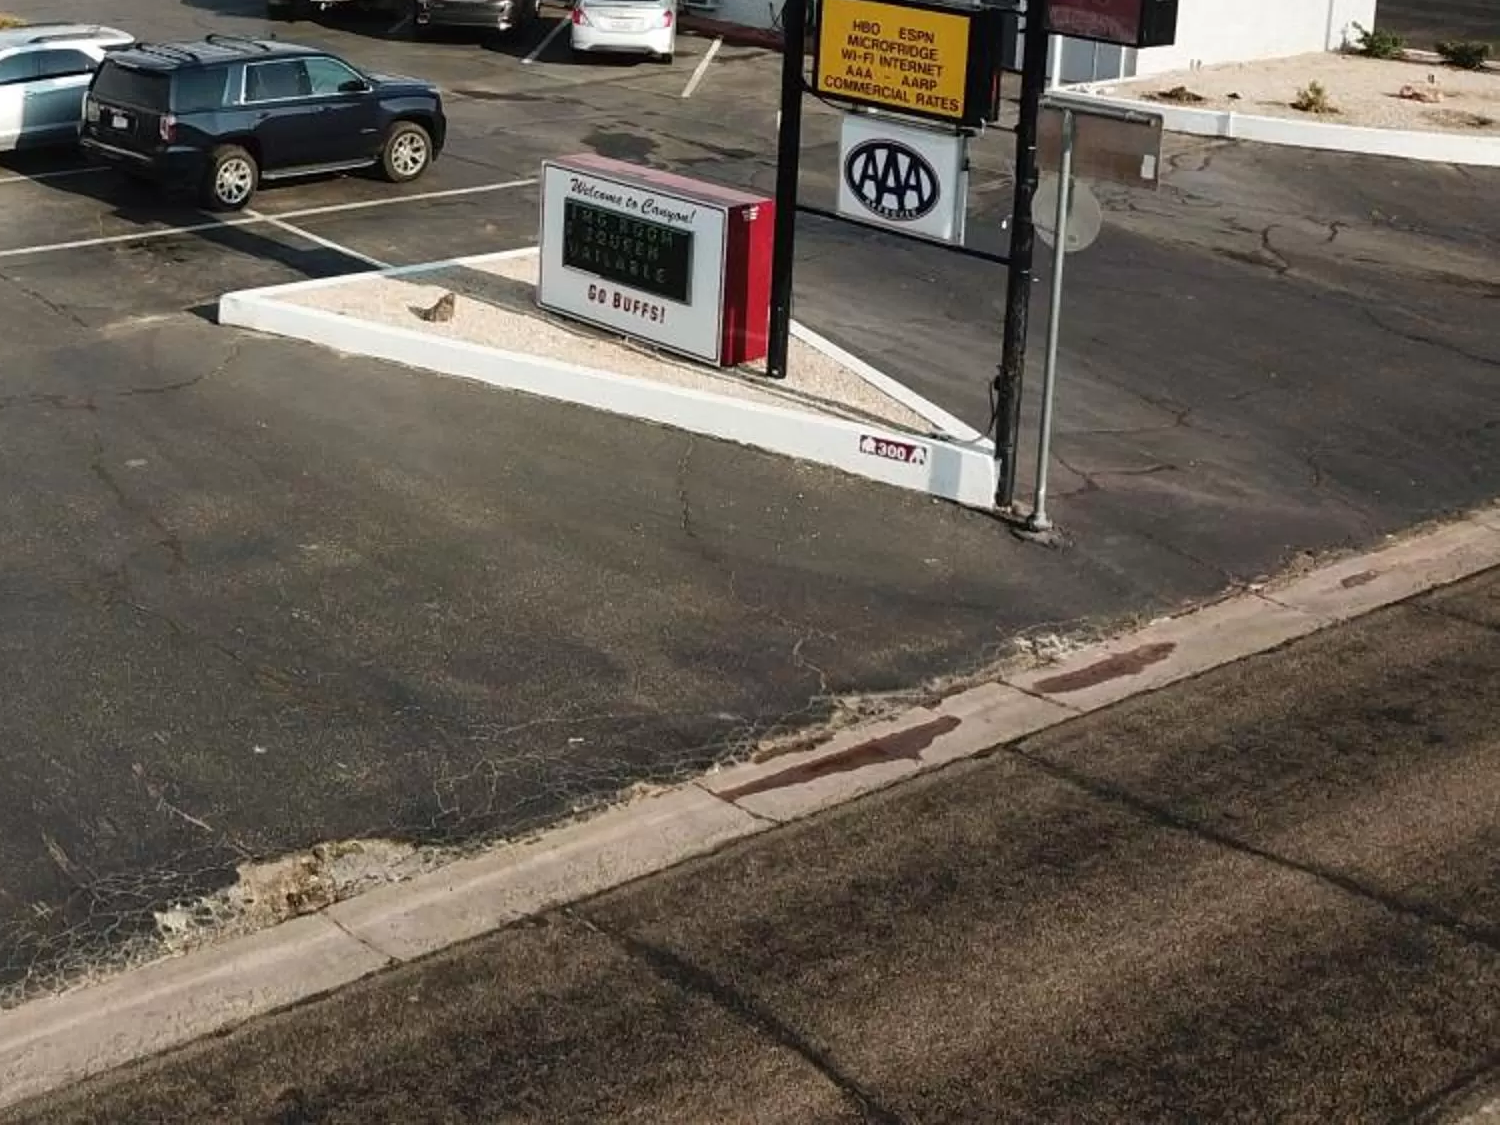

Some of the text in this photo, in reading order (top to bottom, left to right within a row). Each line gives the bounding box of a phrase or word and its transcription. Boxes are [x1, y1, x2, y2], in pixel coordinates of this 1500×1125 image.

[853, 20, 935, 43] HBO ESPN
[841, 48, 944, 78] WI-FI INTERNET
[847, 35, 939, 61] MICROFRIDGE
[824, 74, 959, 112] COMMERCIAL RATES
[846, 65, 873, 80] AAA
[902, 75, 938, 91] AARP
[570, 178, 622, 204] Welcome
[625, 195, 638, 209] to
[849, 142, 934, 215] AAA
[588, 284, 665, 324] GO BUFFS!
[877, 442, 907, 460] 300
